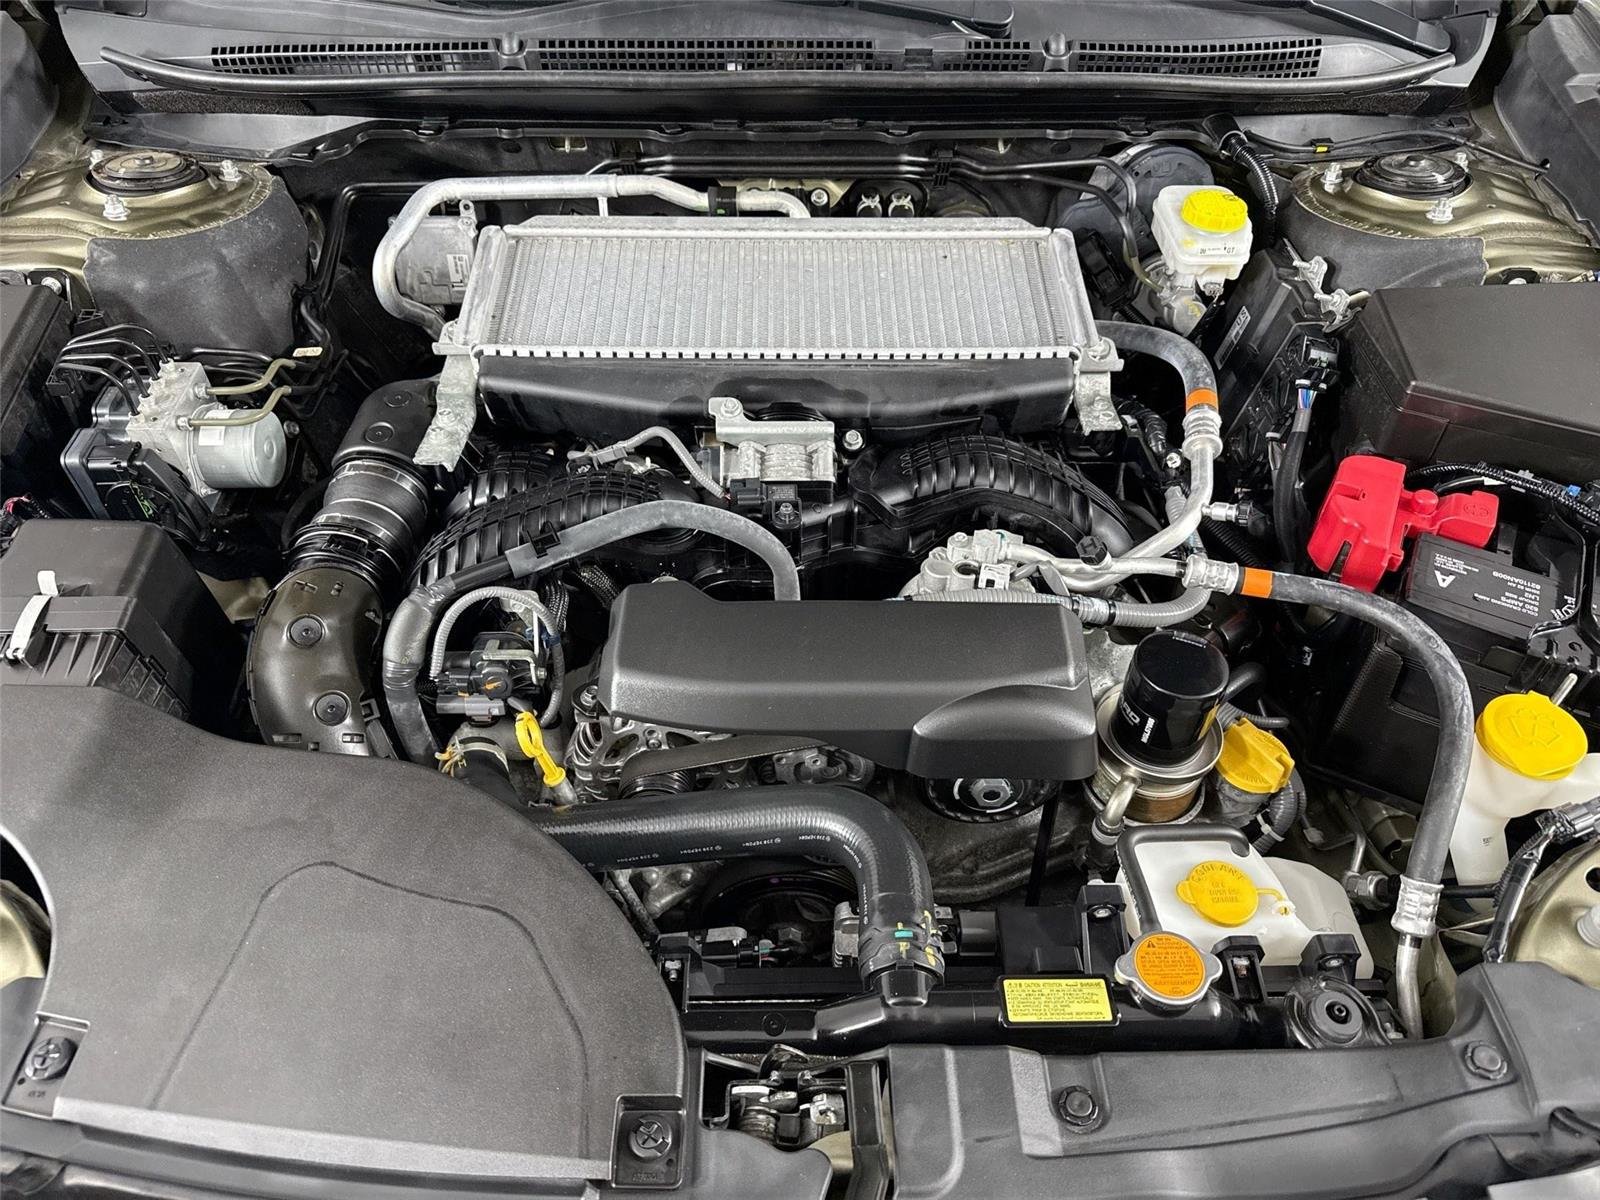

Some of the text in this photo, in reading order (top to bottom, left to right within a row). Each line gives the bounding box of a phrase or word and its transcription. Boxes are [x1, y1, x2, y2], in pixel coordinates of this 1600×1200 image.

[1080, 538, 1097, 553] H
[1490, 598, 1521, 611] CRANKING
[1500, 596, 1524, 607] AMPS
[1521, 608, 1539, 616] COLD
